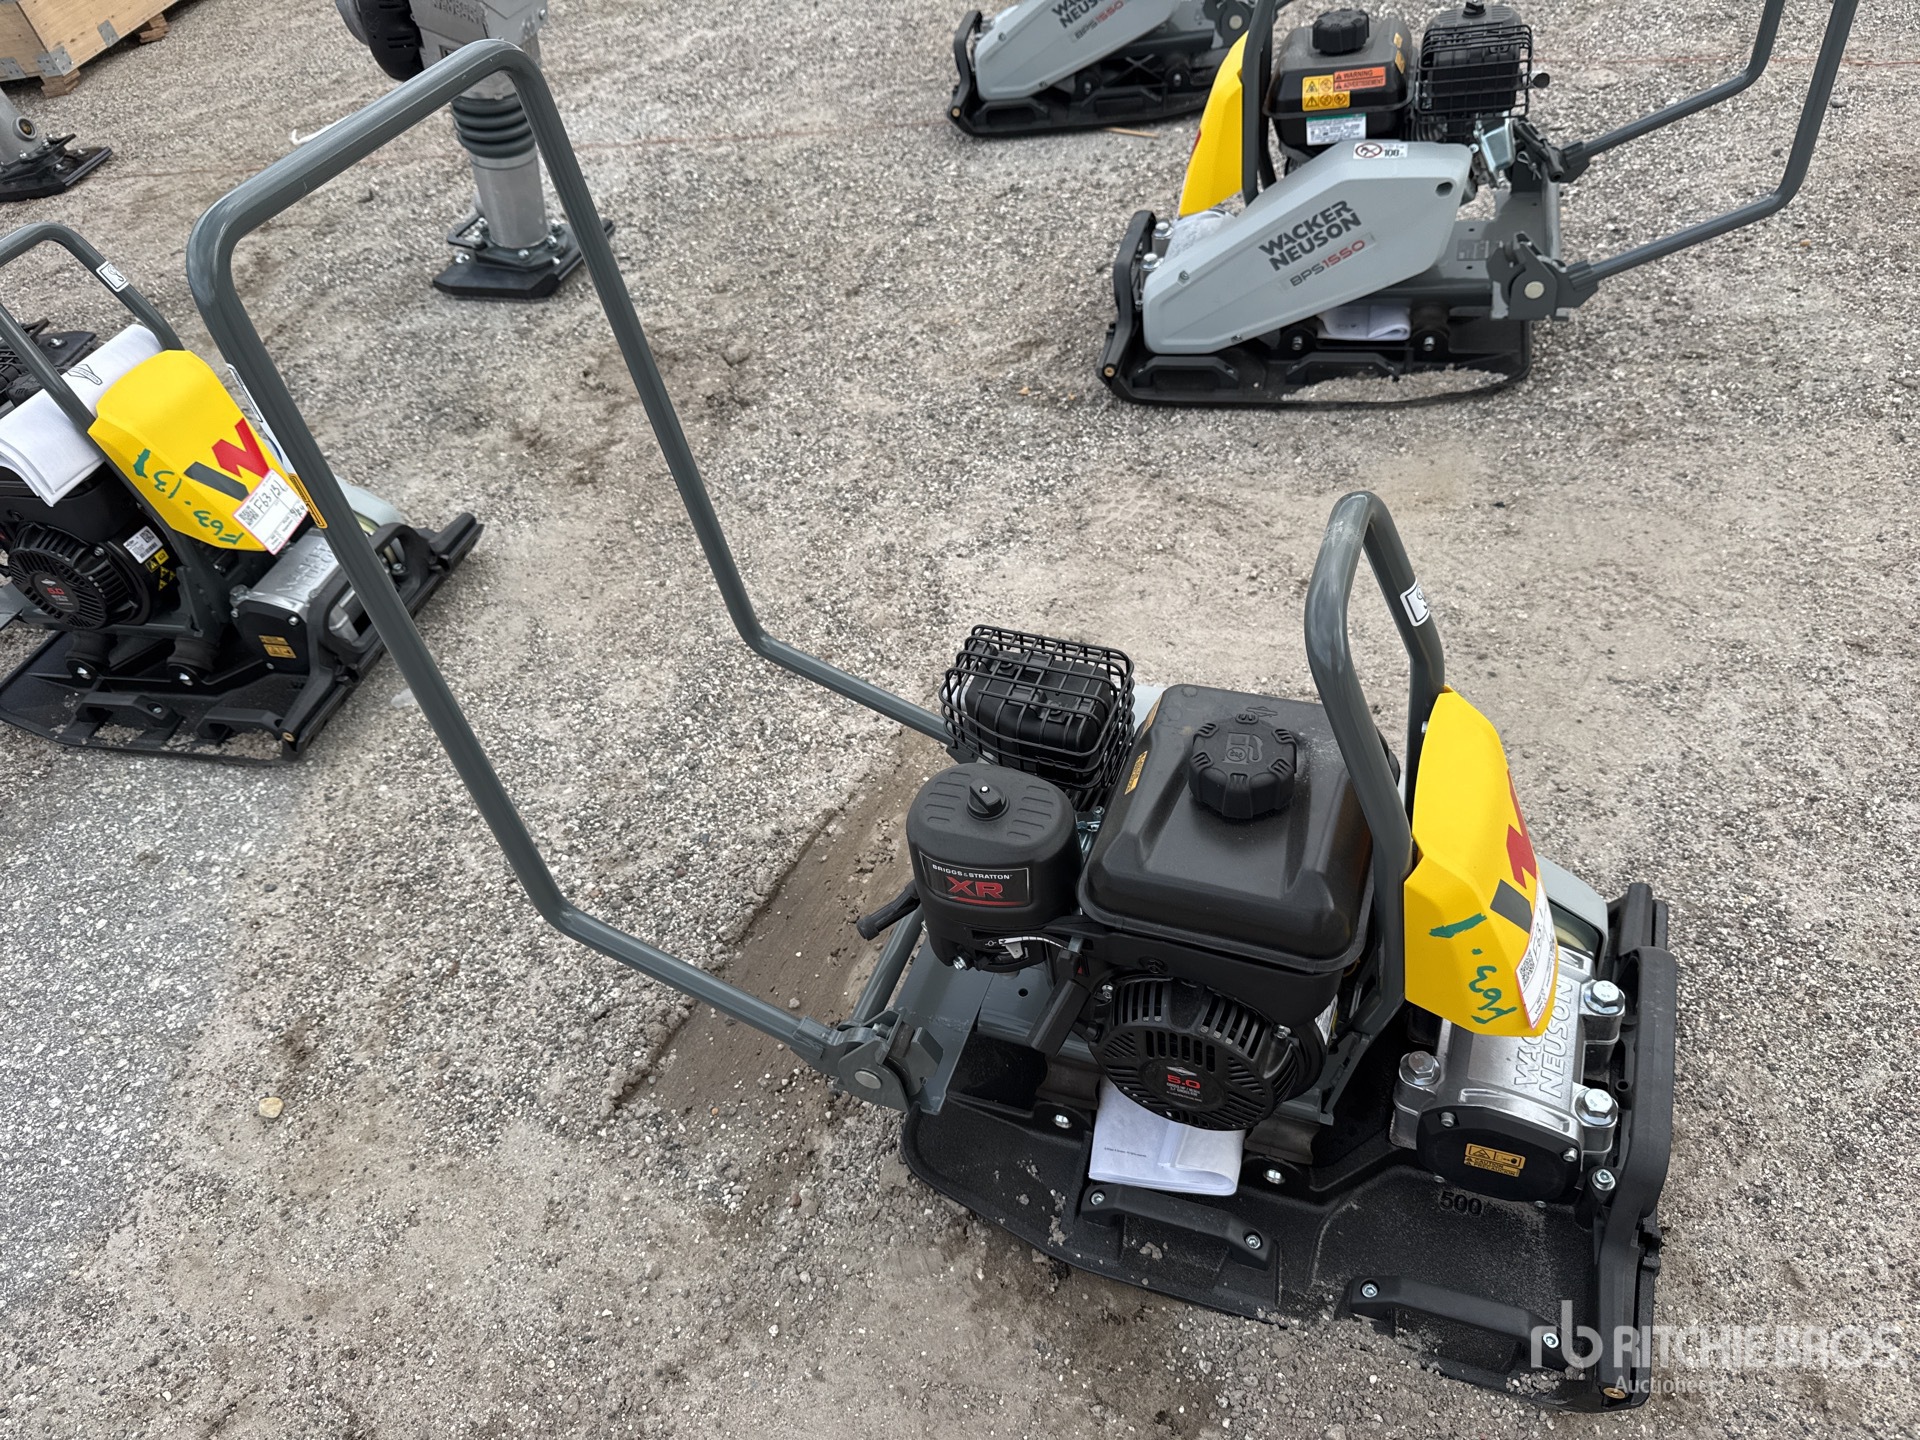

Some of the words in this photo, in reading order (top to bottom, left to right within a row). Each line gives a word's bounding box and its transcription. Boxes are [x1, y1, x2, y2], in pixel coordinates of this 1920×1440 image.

[1343, 69, 1374, 79] WARNING
[1258, 200, 1354, 256] WACKER
[1269, 212, 1362, 271] NEUSON
[1289, 240, 1365, 287] BPS1550
[932, 864, 963, 877] BRIGGS
[946, 875, 1004, 899] XR
[1539, 980, 1573, 1099] NEUSON
[1167, 1074, 1201, 1090] 5.0
[1440, 1191, 1483, 1216] 500
